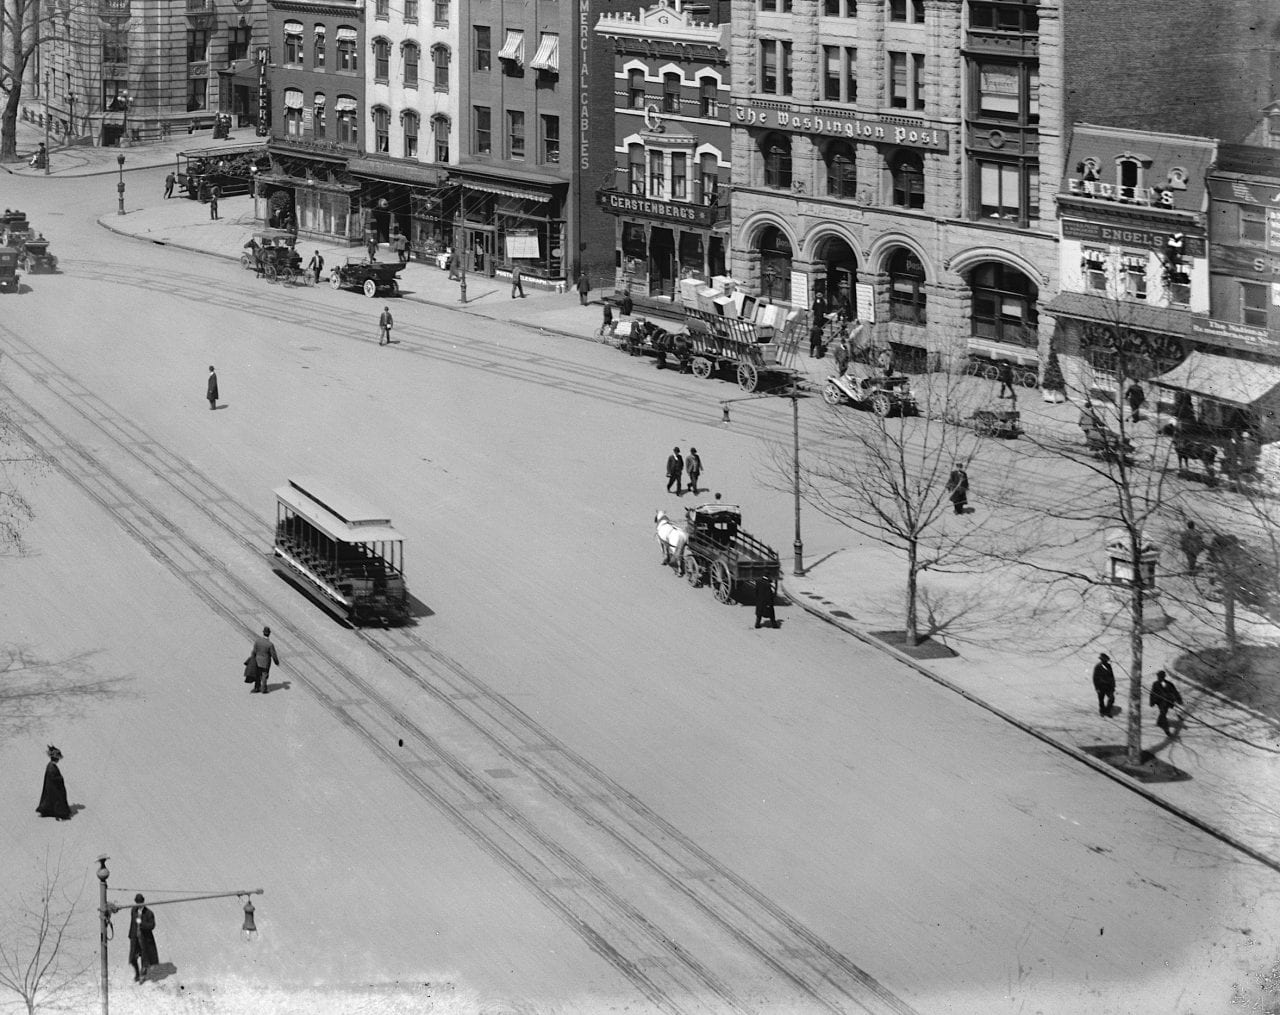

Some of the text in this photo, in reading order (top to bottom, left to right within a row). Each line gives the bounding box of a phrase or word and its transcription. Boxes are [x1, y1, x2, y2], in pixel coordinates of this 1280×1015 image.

[580, 92, 590, 170] CABLES
[734, 105, 940, 145] The Washington Post
[1068, 177, 1174, 206] ENGEL'S
[610, 194, 696, 220] GERSTENBERG'S
[1102, 227, 1164, 247] ENGEL'S
